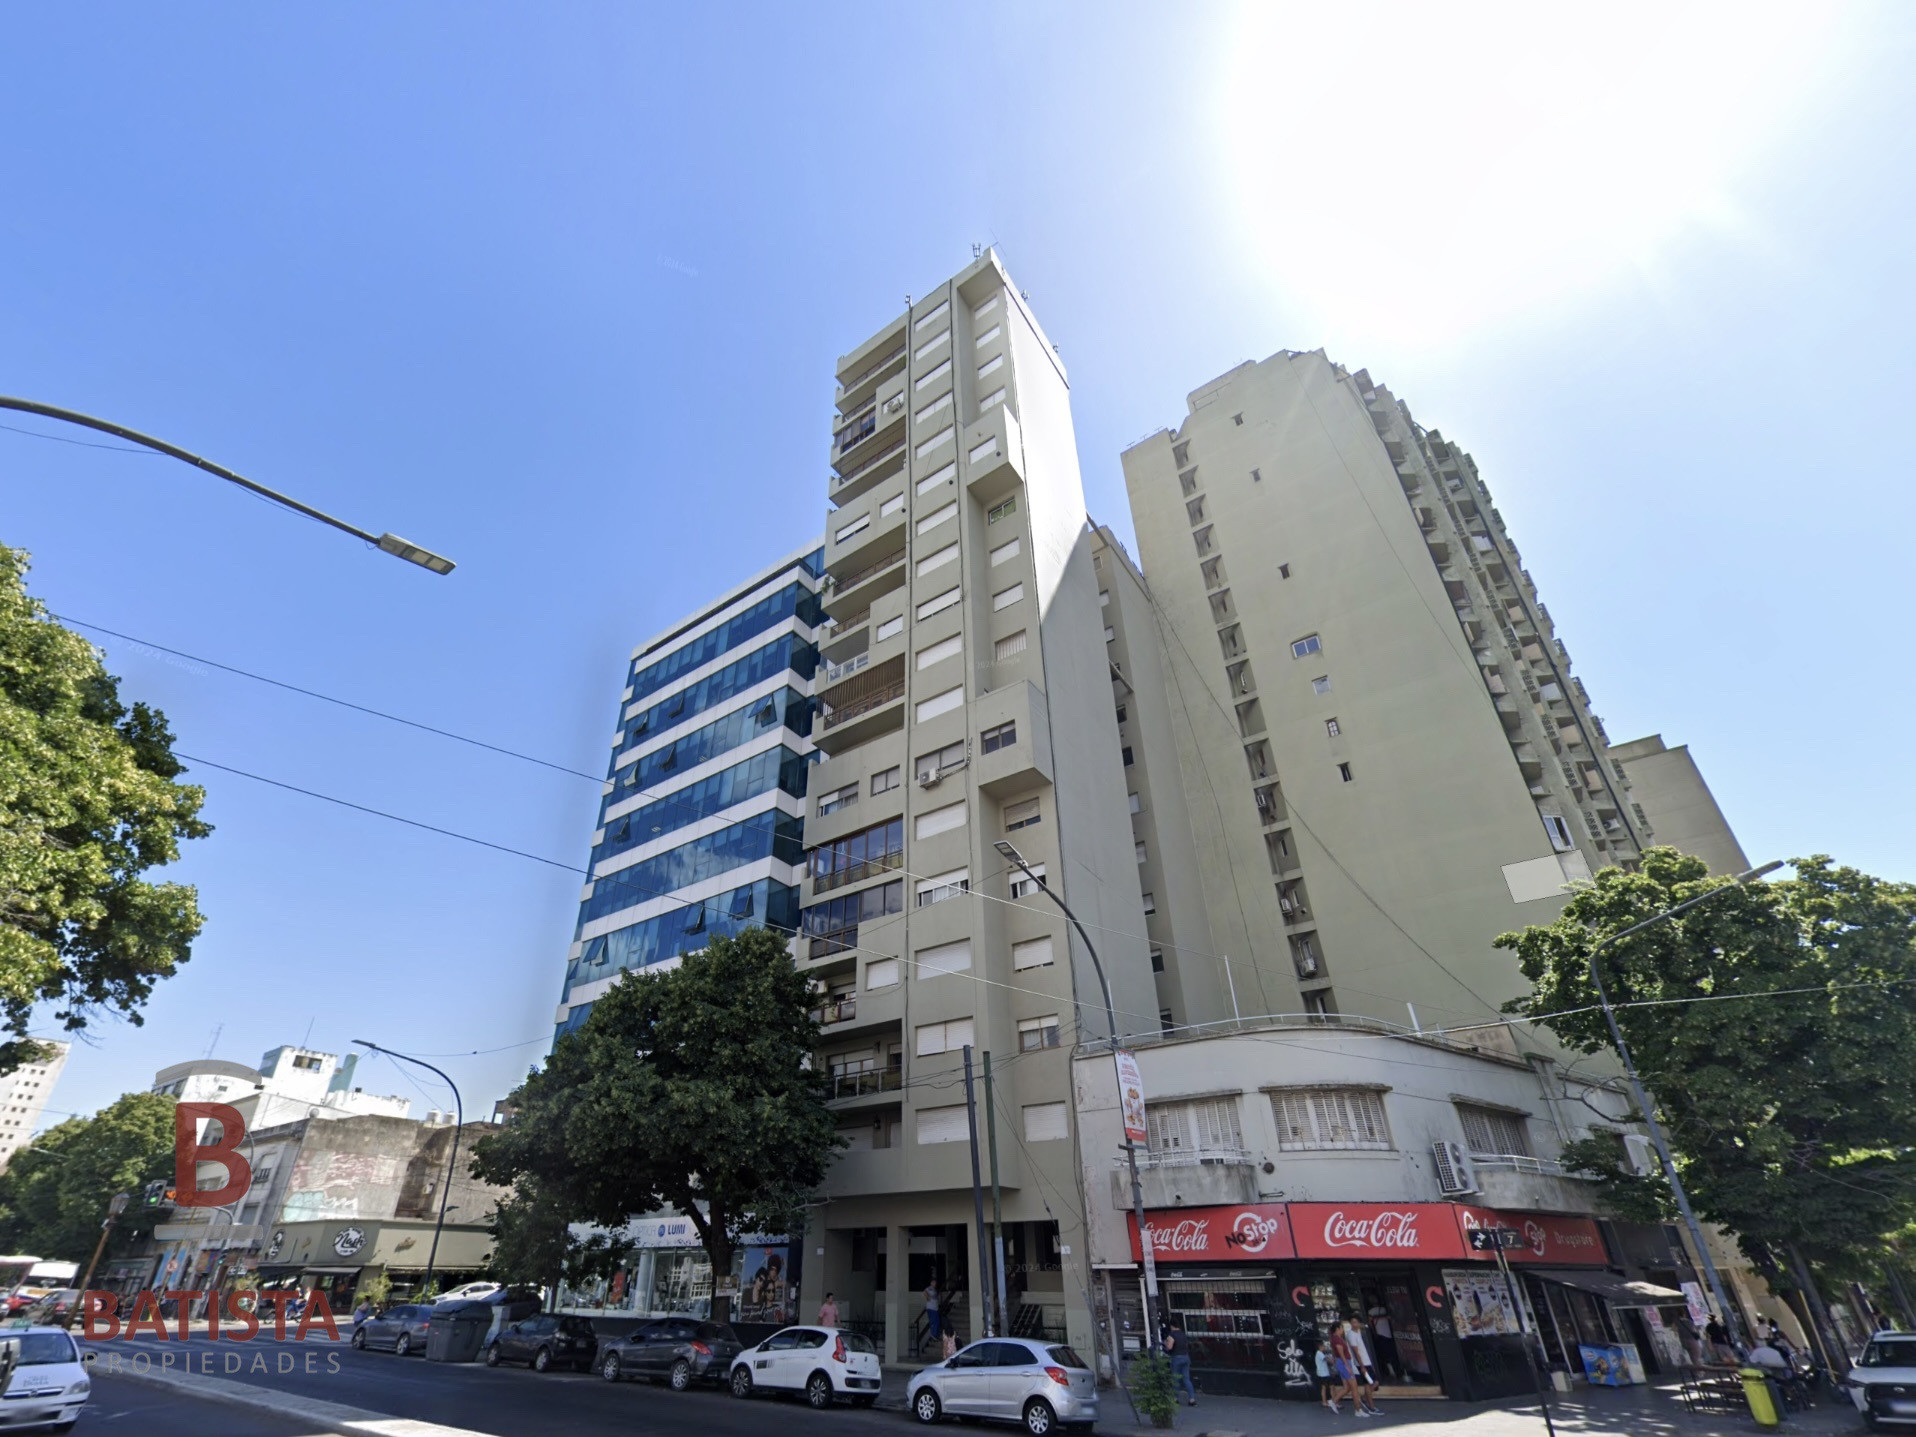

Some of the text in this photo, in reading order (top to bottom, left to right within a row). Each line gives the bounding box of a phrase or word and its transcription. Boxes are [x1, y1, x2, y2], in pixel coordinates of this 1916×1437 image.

[1243, 1218, 1278, 1241] Stop
[1324, 1211, 1418, 1248] Coca-Cola
[333, 1232, 364, 1249] Nash
[1507, 1235, 1514, 1245] 7
[1553, 1231, 1595, 1248] Drugstore
